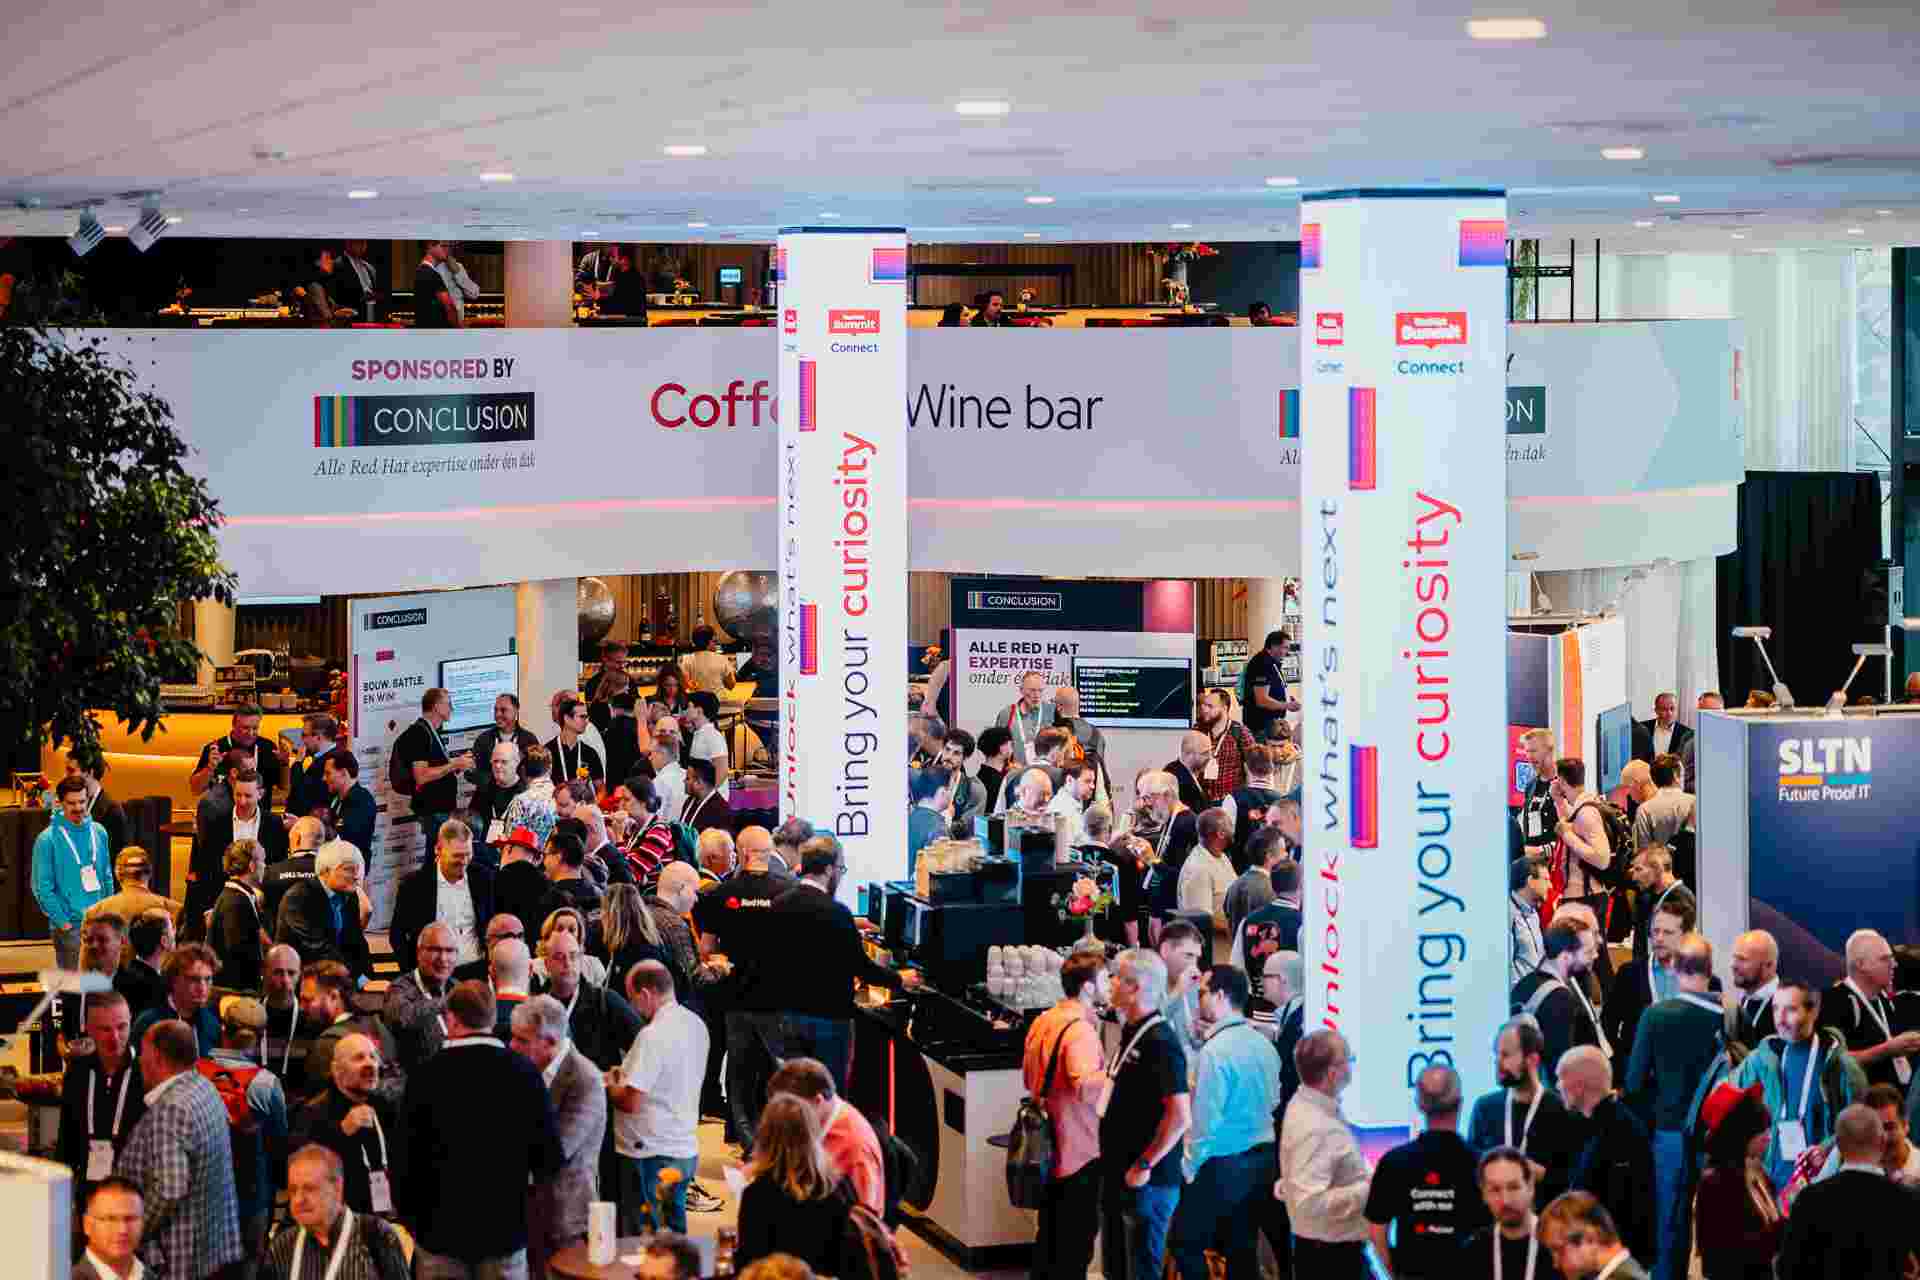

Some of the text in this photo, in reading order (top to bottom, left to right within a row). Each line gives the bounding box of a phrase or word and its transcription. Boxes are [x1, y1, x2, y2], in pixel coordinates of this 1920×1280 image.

[831, 343, 878, 353] Connect
[352, 358, 514, 381] SPONSORED BY
[1398, 360, 1464, 374] Connect
[650, 380, 1103, 430] Coff Wine bar
[374, 404, 528, 433] CONCLUSION
[314, 457, 345, 476] Alle
[351, 457, 378, 474] Red
[384, 457, 408, 473] Hat
[412, 455, 466, 478] expertise
[1320, 500, 1338, 627] next
[987, 595, 1056, 607] CONCLUSION
[376, 612, 425, 625] CONCLUSION
[832, 432, 878, 837] Bring your curiosity
[969, 641, 1080, 655] ALLE RED HAT
[969, 656, 1053, 670] EXPERTISE
[969, 670, 1008, 685] onder
[1318, 645, 1339, 830] what's
[1778, 738, 1872, 773] SLTN
[1402, 488, 1466, 1088] Bring your curiosity
[1778, 784, 1870, 802] Future Proof IT
